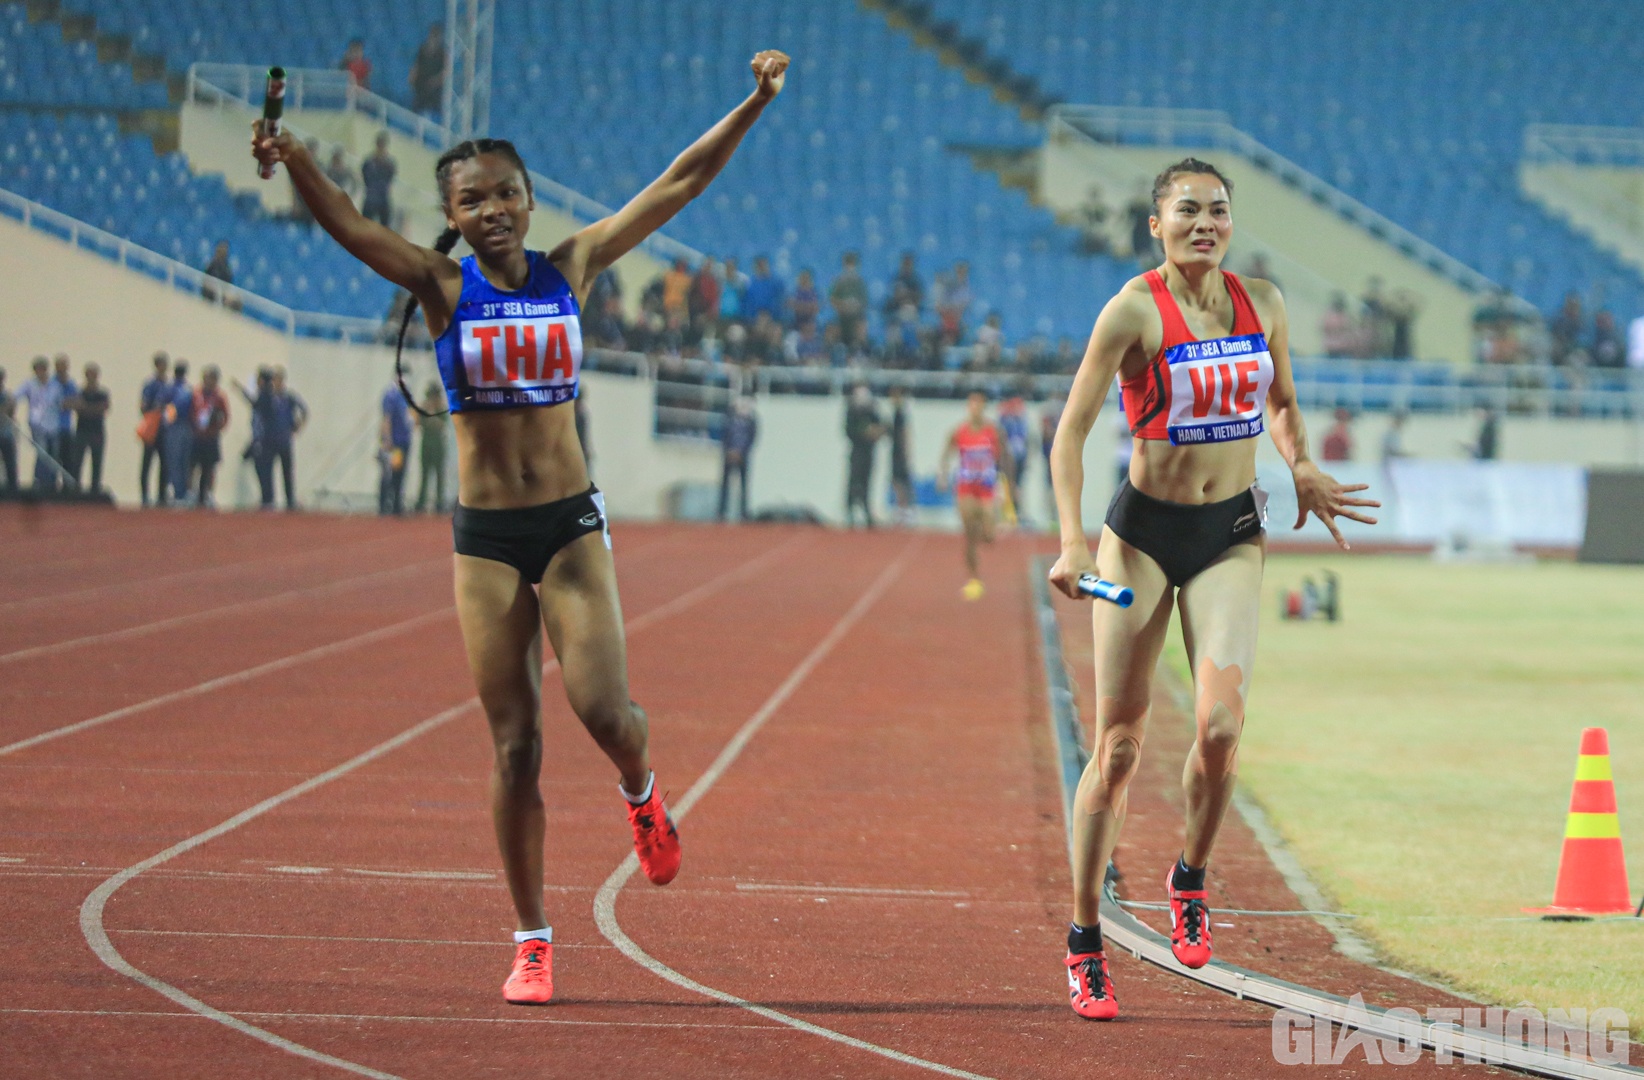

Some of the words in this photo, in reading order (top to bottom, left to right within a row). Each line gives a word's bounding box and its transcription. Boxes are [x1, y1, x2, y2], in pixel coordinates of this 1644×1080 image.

[504, 302, 523, 316] SEA
[524, 303, 559, 315] Games
[472, 323, 573, 382] THA
[1201, 341, 1220, 357] SEA
[1221, 339, 1253, 354] Games
[475, 391, 504, 403] HANOI
[512, 390, 553, 403] VIETNAM
[1188, 360, 1260, 418] VIE
[1177, 428, 1206, 442] HANOI
[1212, 424, 1249, 440] VIETNAM
